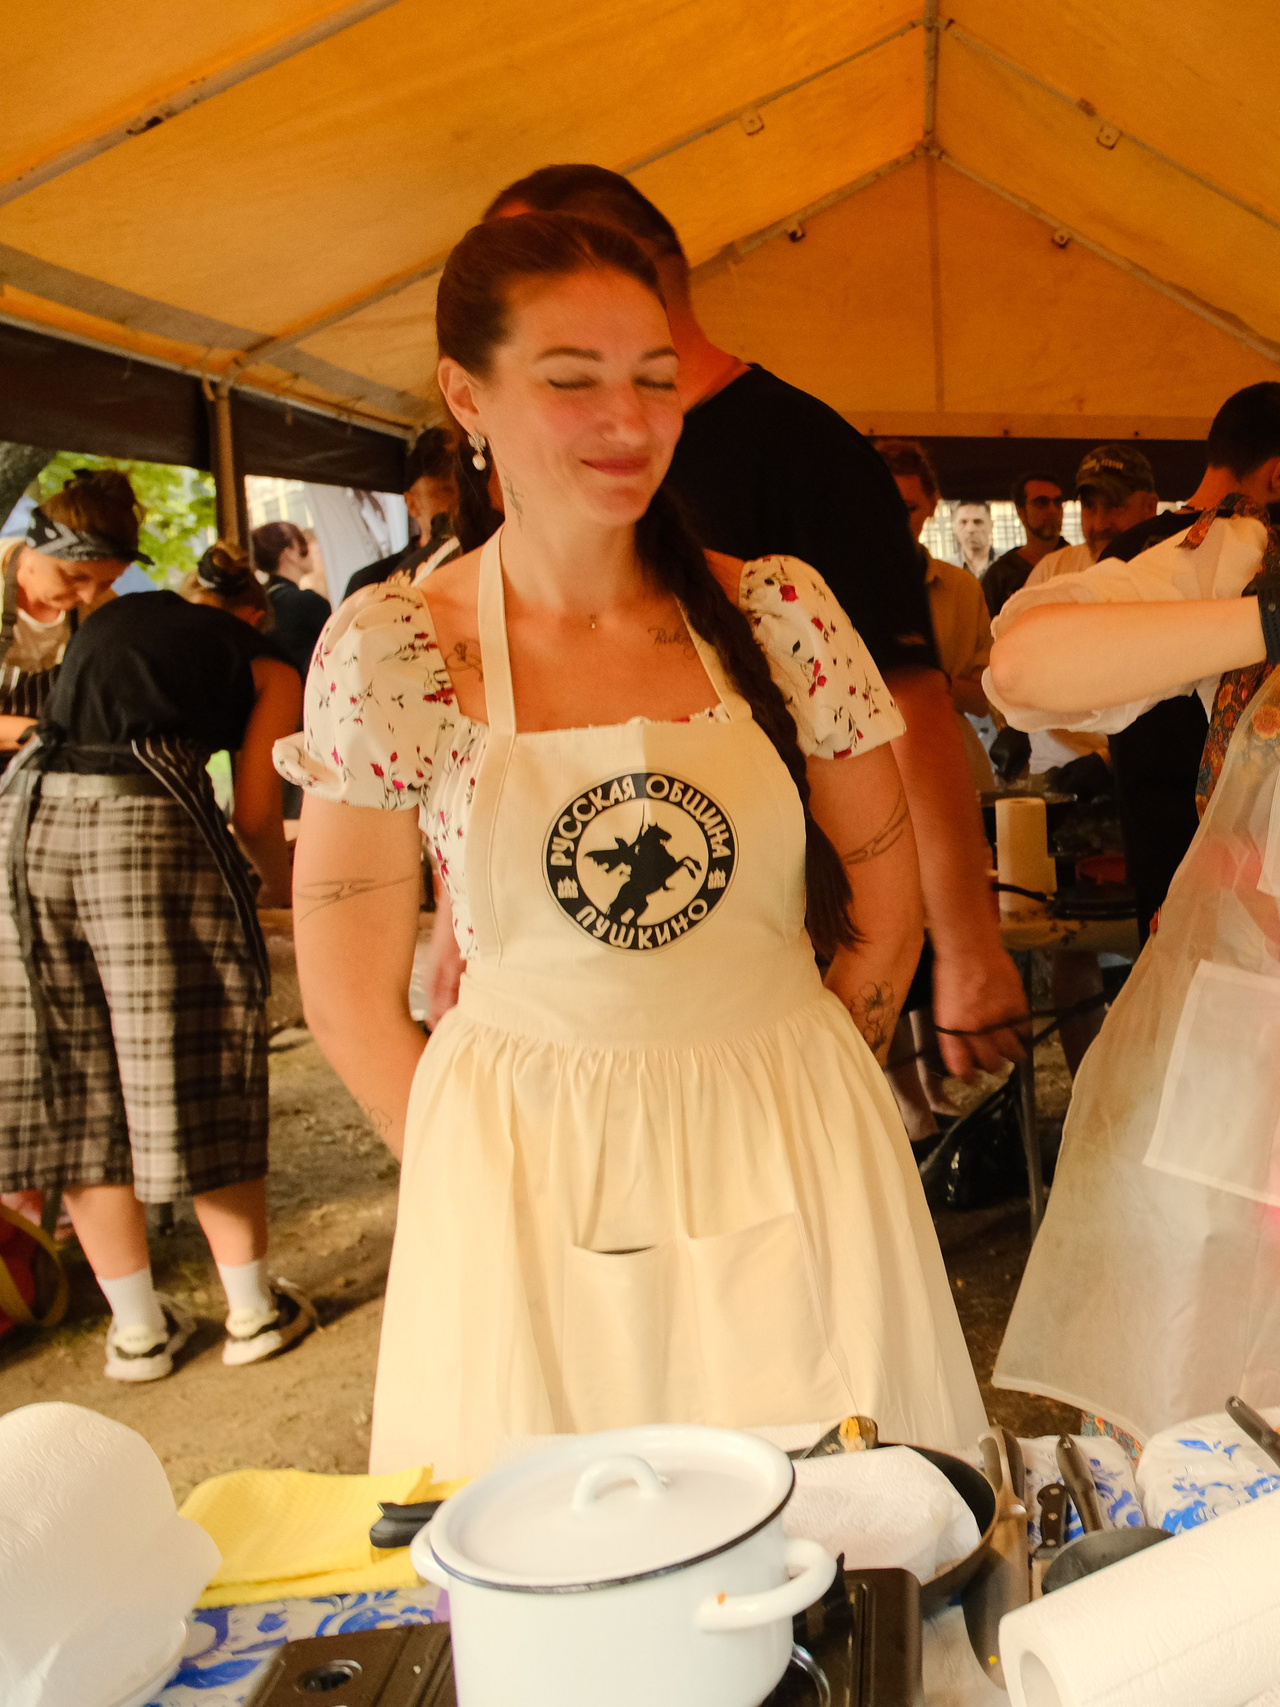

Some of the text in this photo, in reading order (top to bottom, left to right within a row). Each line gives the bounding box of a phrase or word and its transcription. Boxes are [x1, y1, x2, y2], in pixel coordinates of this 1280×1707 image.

[550, 774, 732, 867] РУССКАЯ ОБЩИНА
[575, 898, 708, 950] ПУШКИНО
